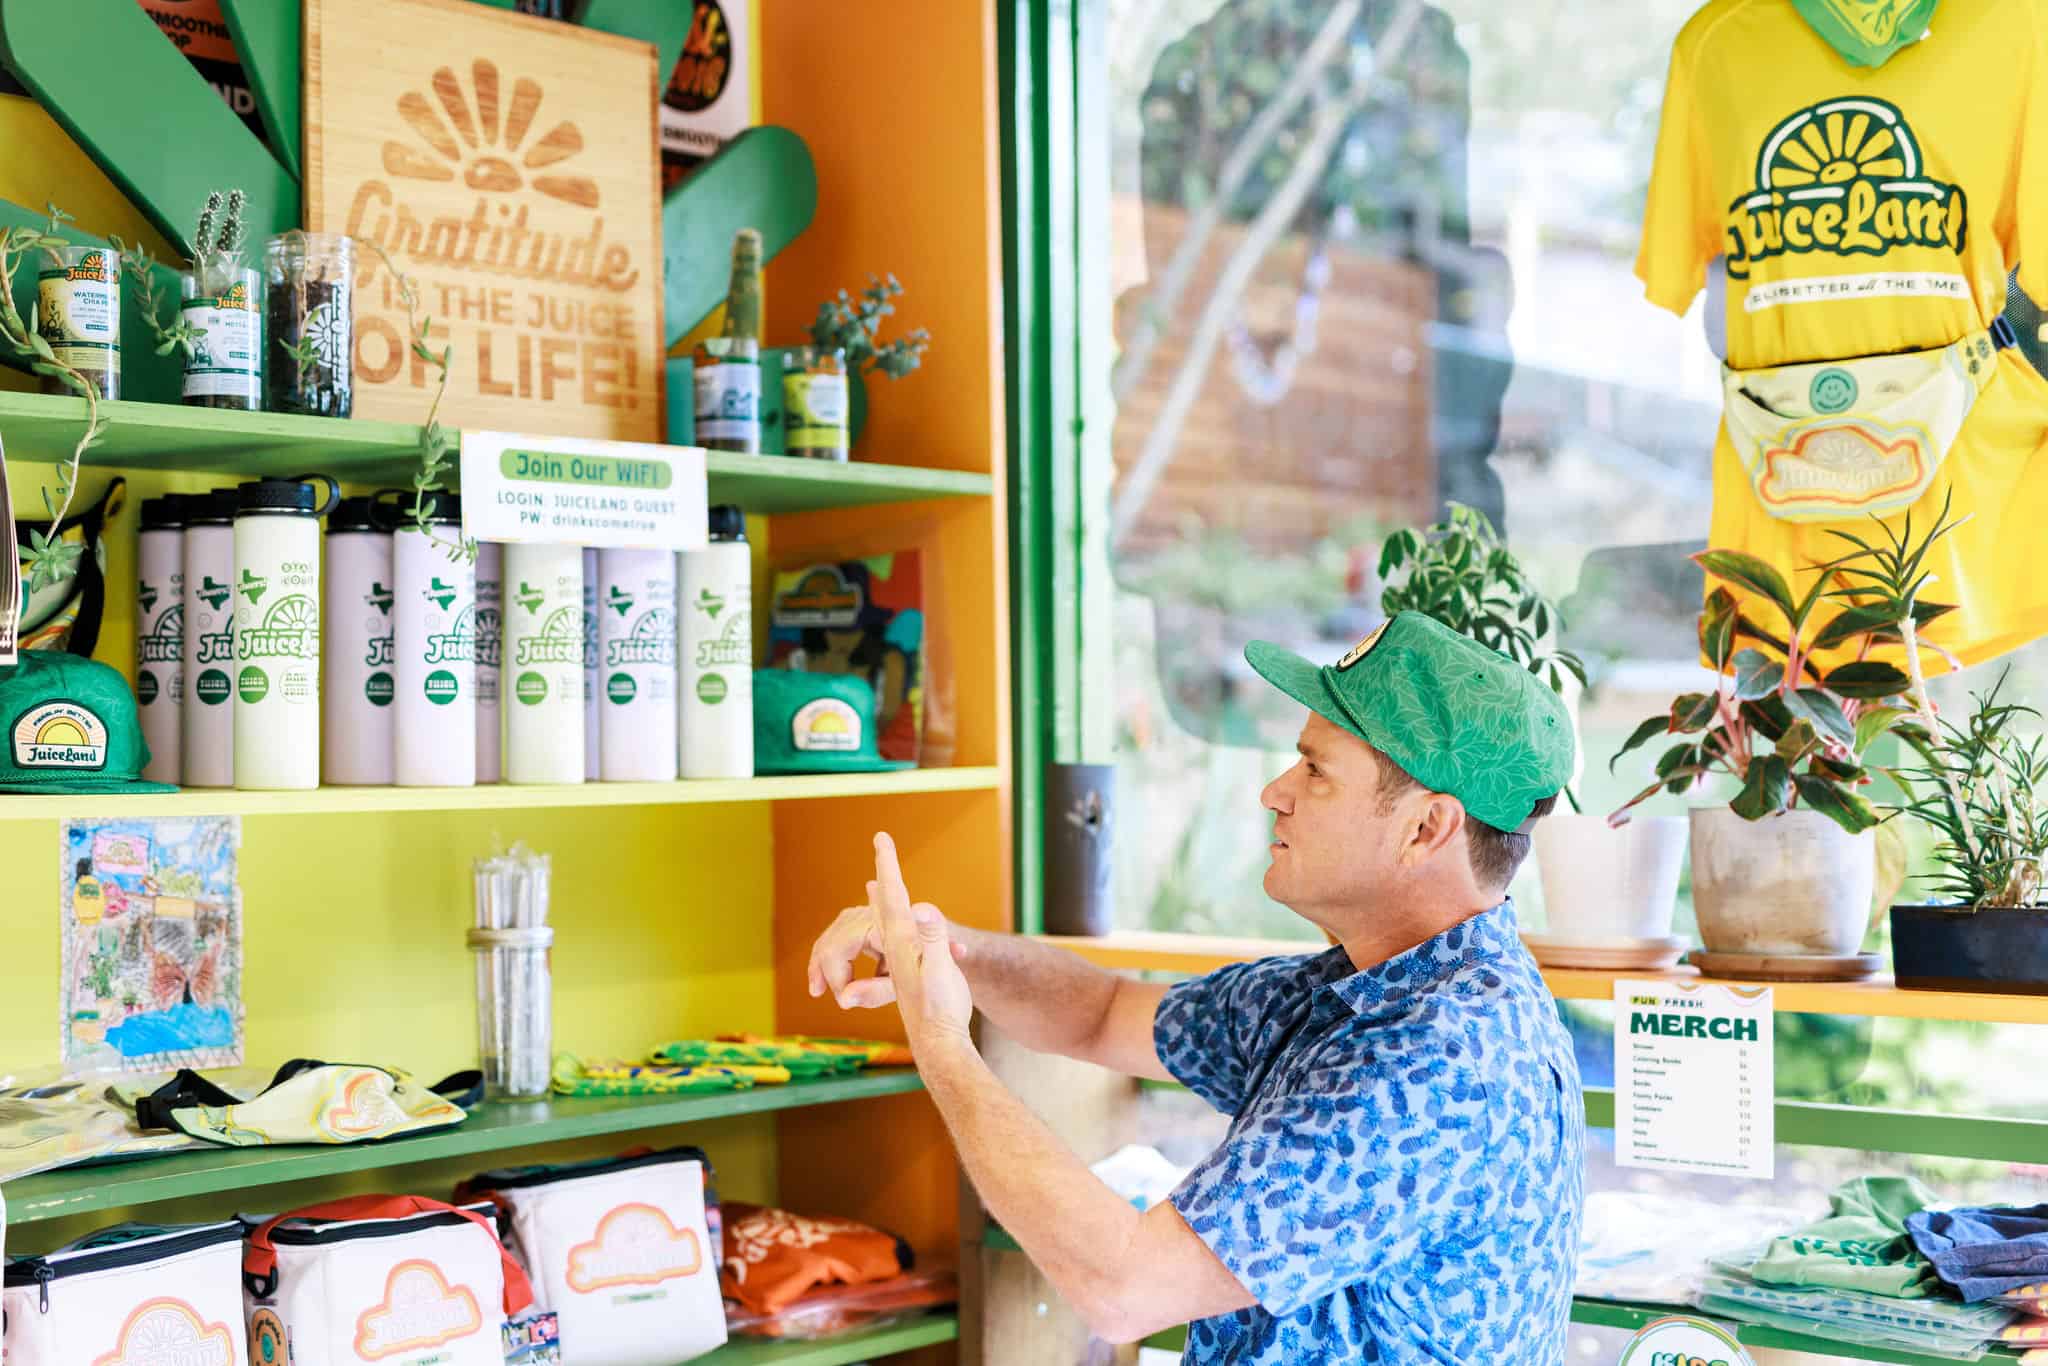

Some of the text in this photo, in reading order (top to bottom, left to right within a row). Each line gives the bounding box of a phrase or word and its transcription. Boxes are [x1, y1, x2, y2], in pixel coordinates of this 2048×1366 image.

[345, 179, 640, 292] Gratitude
[1885, 279, 1914, 289] THE
[432, 280, 515, 326] THE
[526, 294, 637, 341] JUICE
[354, 315, 451, 389] OF
[477, 330, 640, 411] LIFE!
[515, 453, 563, 479] Join
[570, 457, 608, 481] Our
[554, 494, 628, 512] JUICELAND
[633, 499, 676, 515] GUEST
[27, 746, 98, 764] JuiceLand
[1632, 996, 1703, 1008] FUN FRESH
[1630, 1011, 1758, 1041] MERCH
